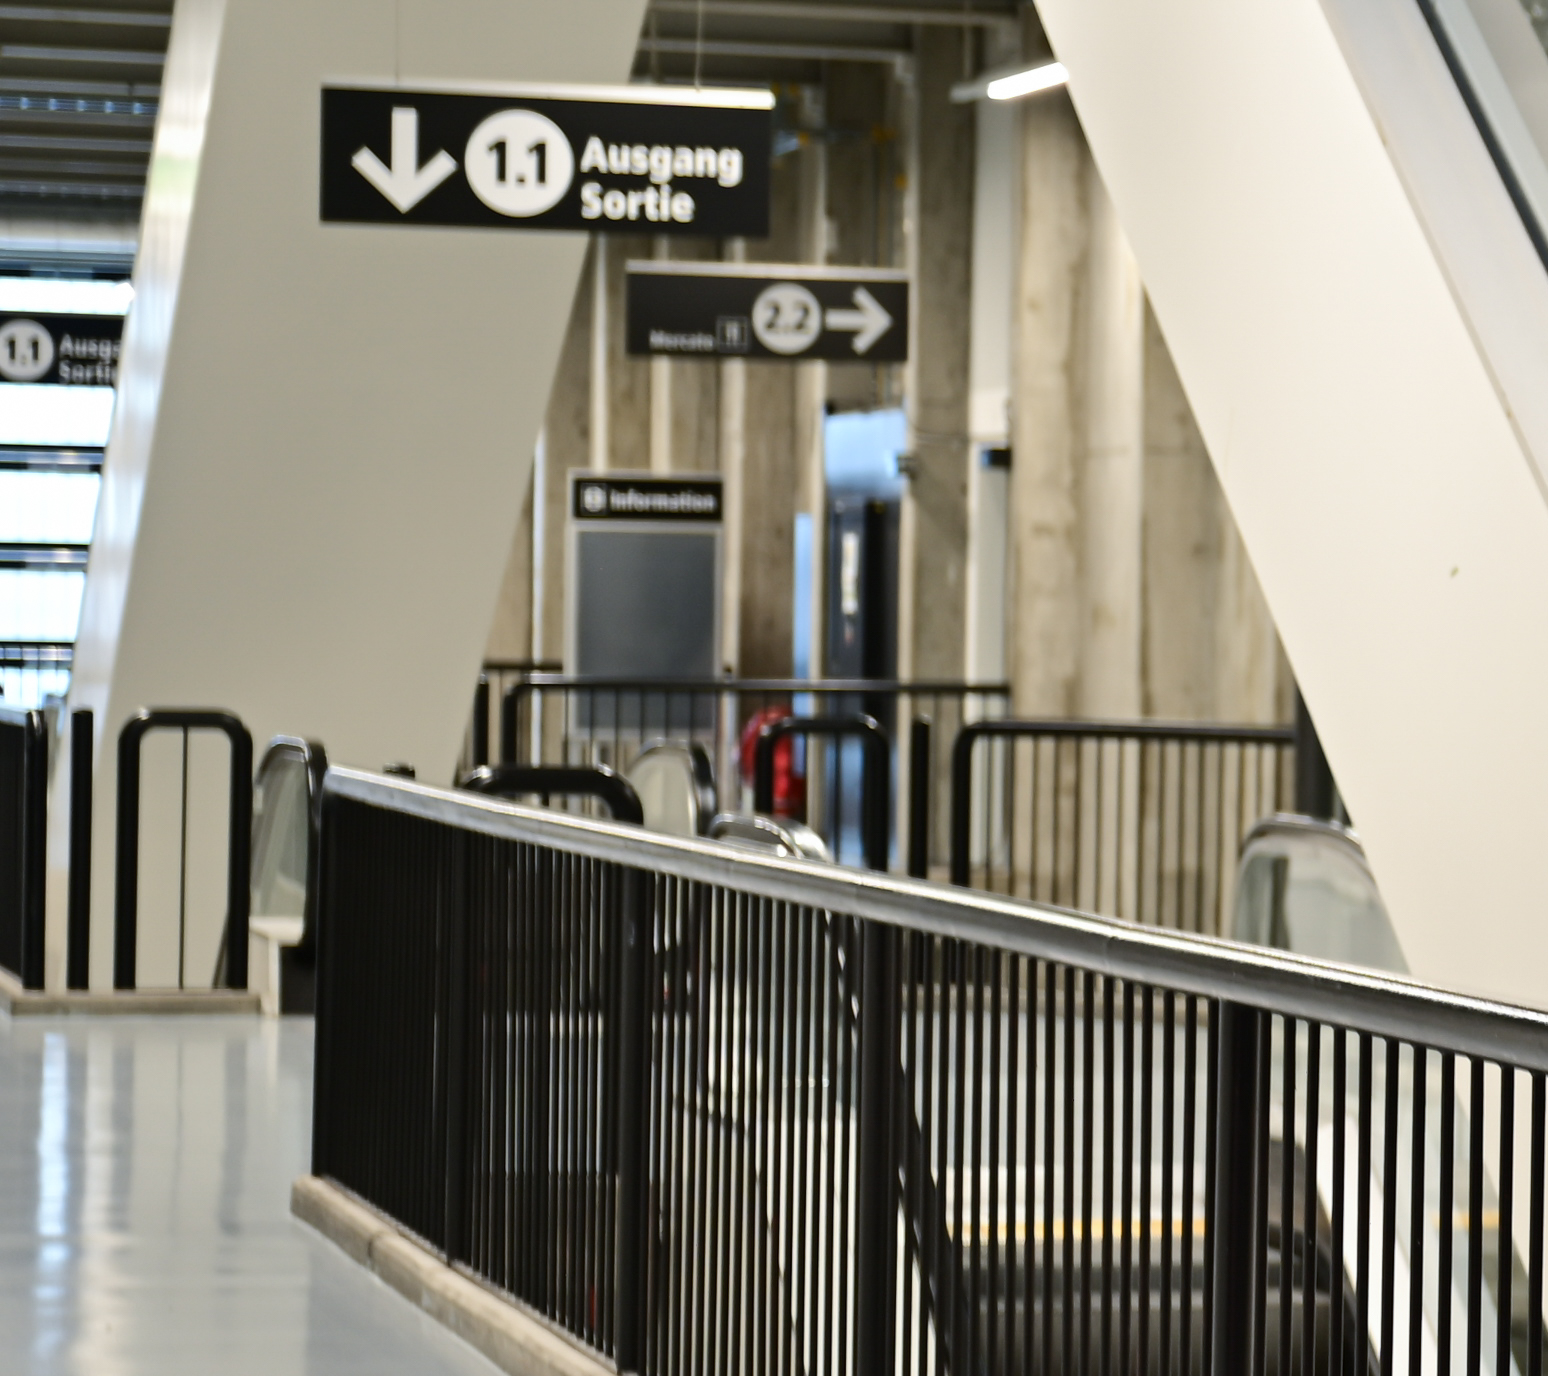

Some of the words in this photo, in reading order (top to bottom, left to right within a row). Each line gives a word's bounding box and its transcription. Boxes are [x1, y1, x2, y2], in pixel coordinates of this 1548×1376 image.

[487, 137, 548, 187] 1.1
[580, 135, 743, 188] Ausgang
[580, 182, 696, 223] Sortie
[764, 300, 811, 334] 2.2
[60, 333, 121, 364] Ausga
[59, 360, 111, 384] Sorti
[610, 488, 716, 513] Information
